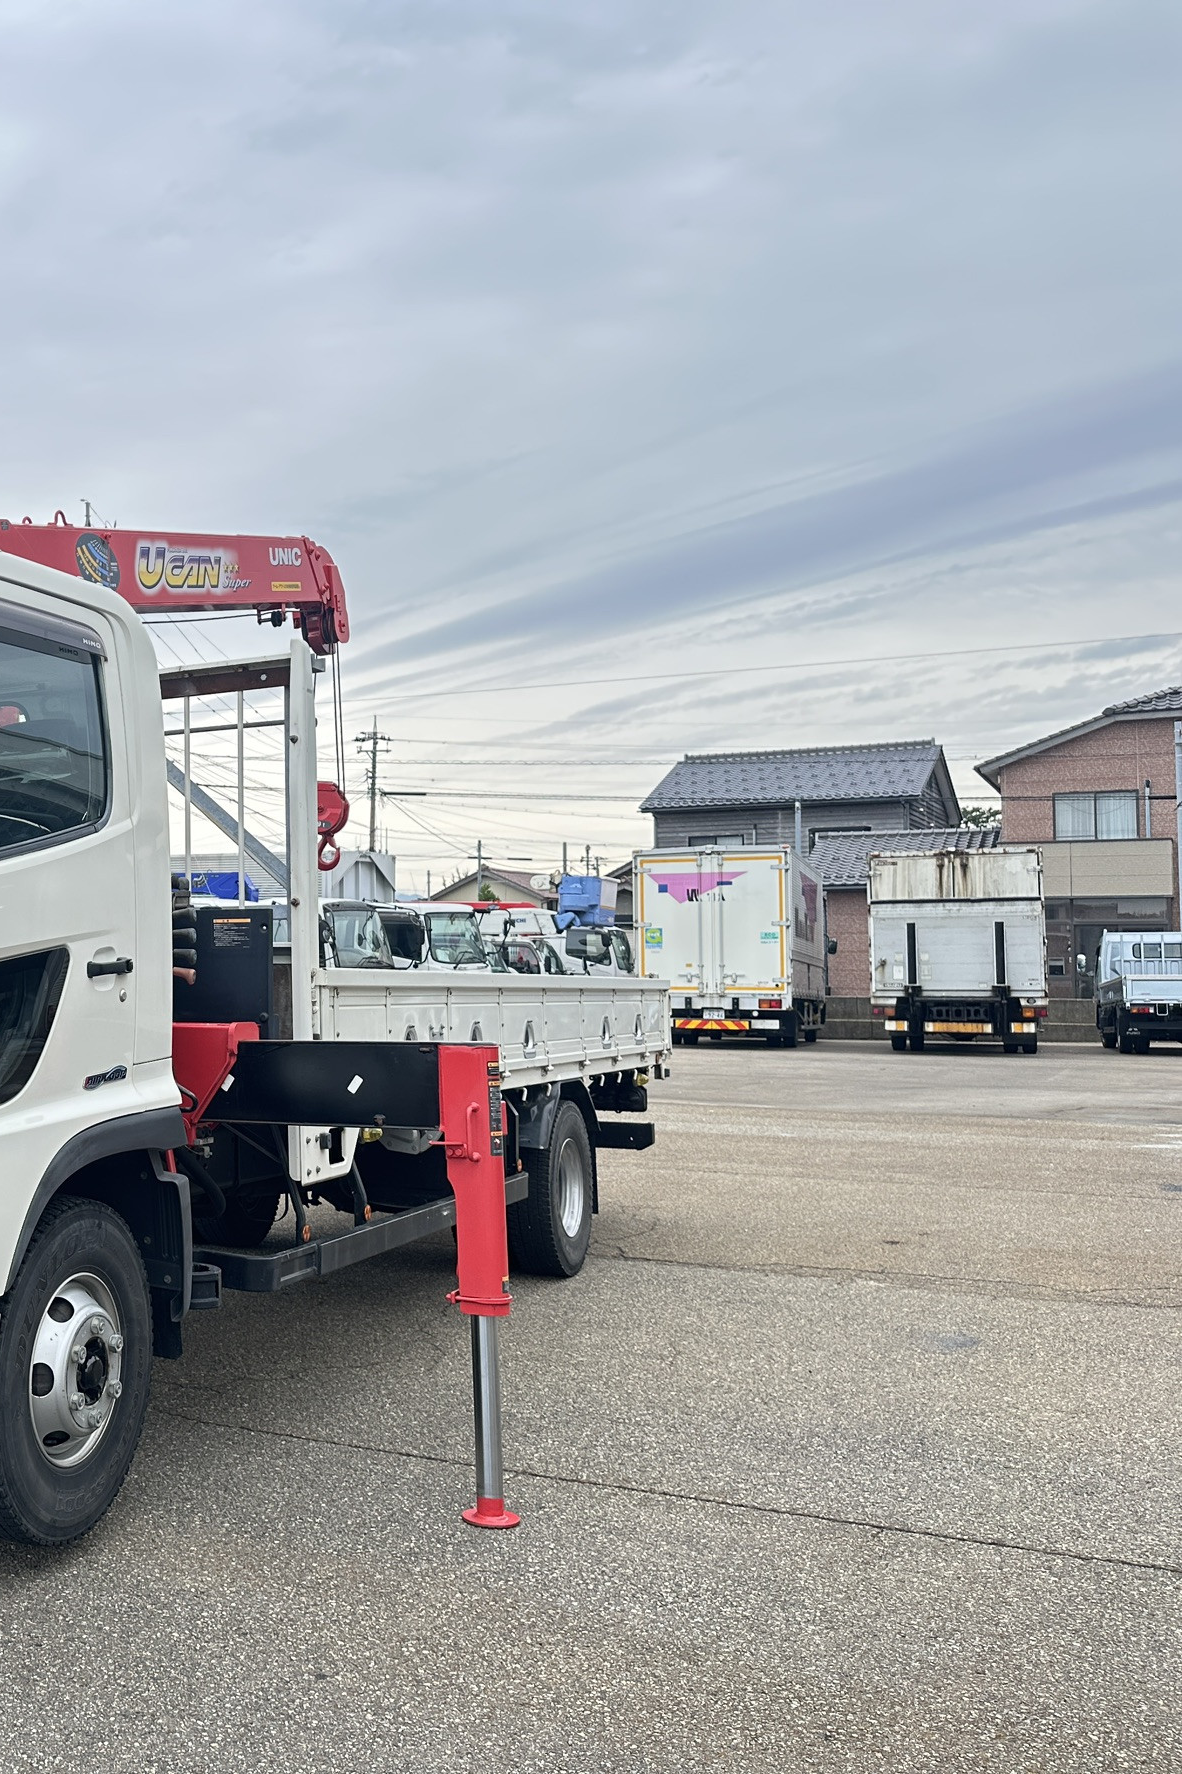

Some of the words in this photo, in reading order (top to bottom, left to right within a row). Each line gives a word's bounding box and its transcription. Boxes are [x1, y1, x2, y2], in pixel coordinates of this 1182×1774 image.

[269, 547, 302, 566] UNIC
[223, 576, 252, 592] Super
[82, 637, 101, 649] HINO
[58, 646, 78, 656] HINO
